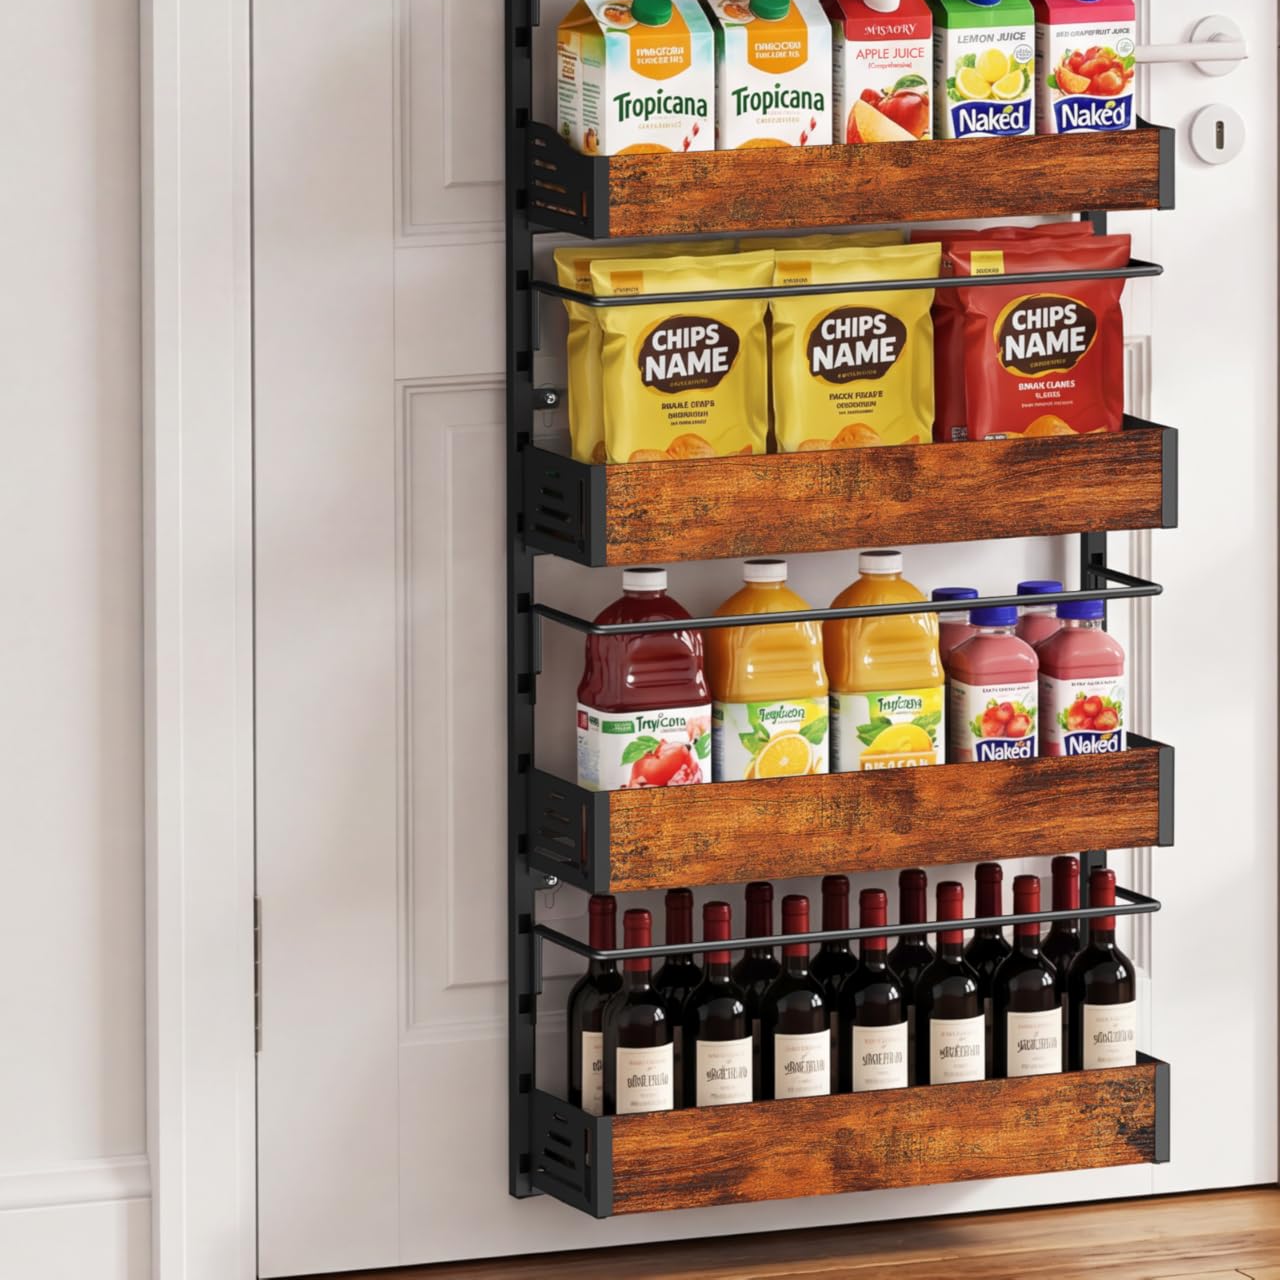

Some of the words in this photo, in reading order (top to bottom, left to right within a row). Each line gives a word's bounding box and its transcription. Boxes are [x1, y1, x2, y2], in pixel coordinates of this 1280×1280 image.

[957, 33, 995, 45] LEMON
[996, 31, 1027, 43] JUICE
[855, 48, 890, 60] APPLE
[892, 47, 926, 59] JUICE
[613, 88, 708, 122] Tropicana
[731, 82, 825, 117] Tropicana
[958, 106, 1024, 133] Naked
[1062, 102, 1126, 129] Naked
[820, 313, 887, 341] CHIPS
[1012, 304, 1077, 331] CHIPS
[651, 323, 720, 352] CHIPS
[1005, 326, 1086, 362] NAME
[645, 346, 729, 382] NAME
[812, 336, 897, 373] NAME
[981, 739, 1031, 762] Naked
[1070, 732, 1118, 756] Naked
